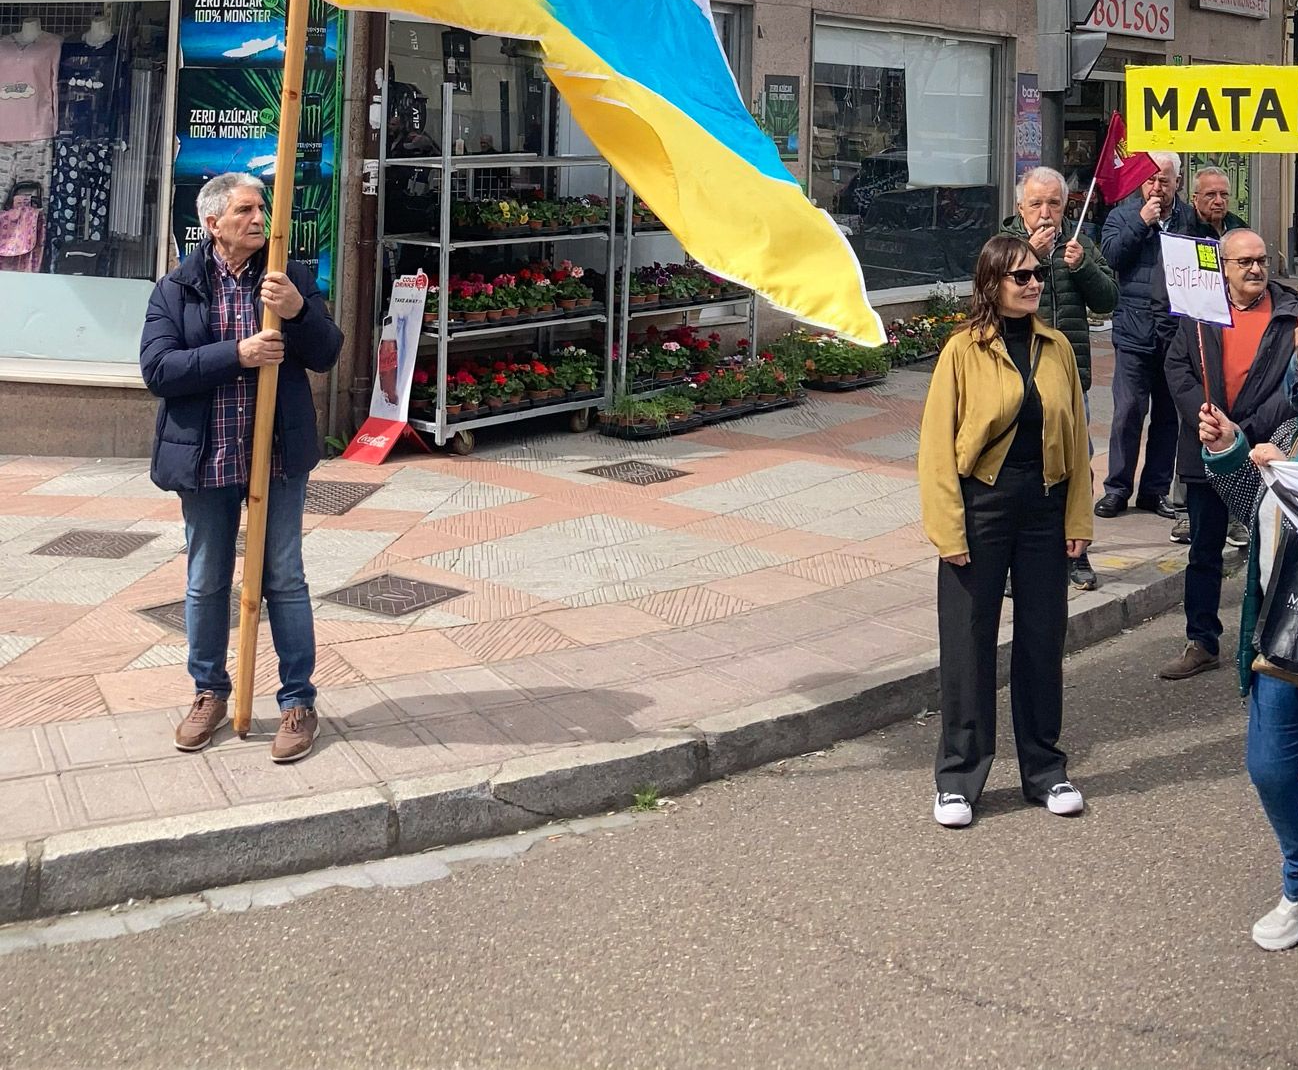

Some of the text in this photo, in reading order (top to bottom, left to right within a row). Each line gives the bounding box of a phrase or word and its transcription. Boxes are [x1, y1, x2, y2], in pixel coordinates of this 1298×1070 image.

[195, 9, 271, 23] 100% MONSTER
[190, 109, 215, 124] ZERO
[218, 107, 258, 123] AZÚCAR
[189, 125, 267, 139] 100% MONSTER
